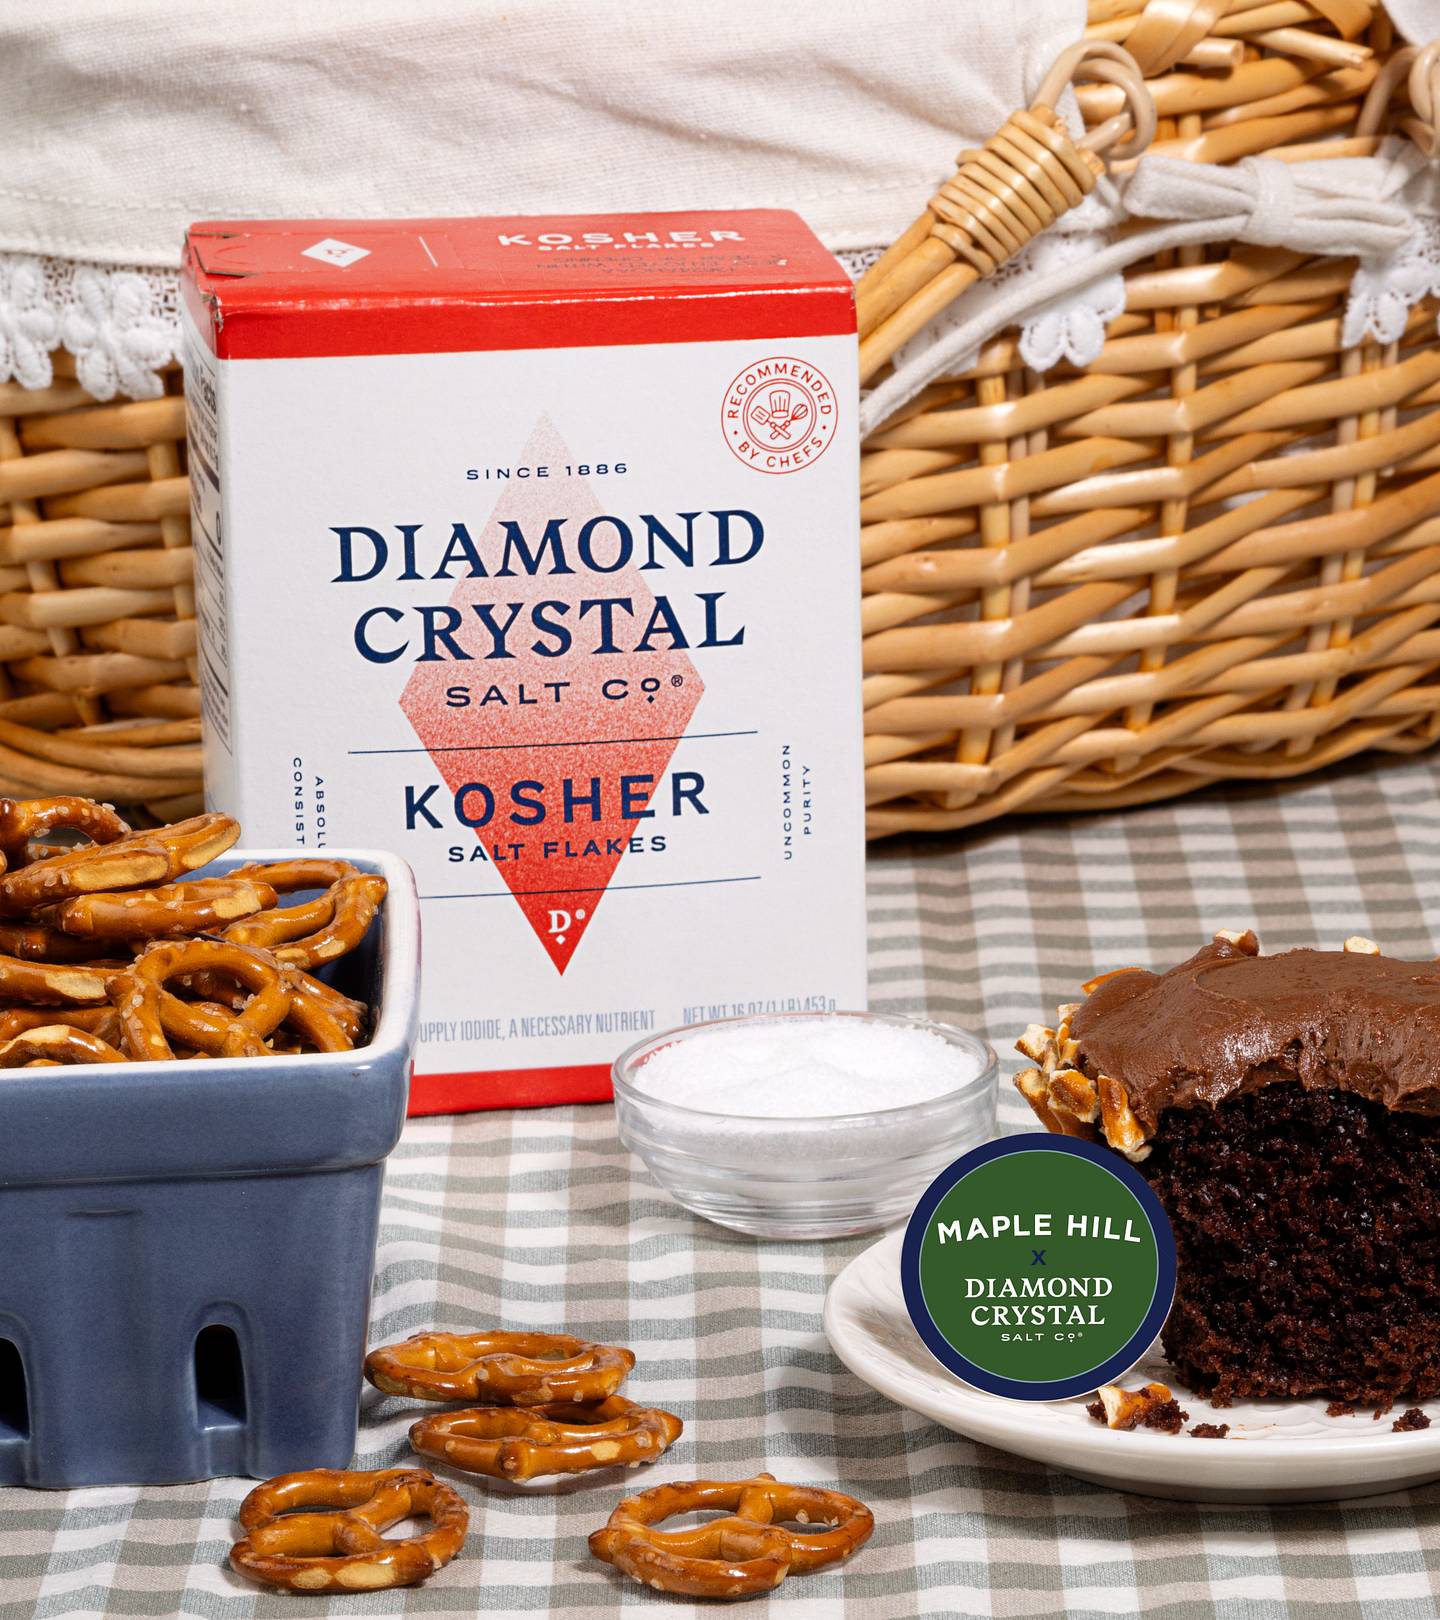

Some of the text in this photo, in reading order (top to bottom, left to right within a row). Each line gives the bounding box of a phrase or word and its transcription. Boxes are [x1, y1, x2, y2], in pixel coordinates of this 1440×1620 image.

[497, 230, 746, 247] KOSHER
[613, 241, 715, 250] FLAKES
[727, 362, 832, 419] RECOMMENDED
[738, 437, 823, 468] BY CHEFS
[466, 463, 629, 480] SINCE 1886
[328, 508, 765, 583] DIAMOND
[353, 591, 746, 665] CRYSTAL
[445, 682, 571, 708] SALT
[404, 771, 710, 830] KOSHER
[782, 745, 793, 861] UNCOMMON
[802, 765, 812, 835] PURITY
[448, 836, 668, 863] SALT FLAKES
[460, 1019, 506, 1042] IODIDE,
[508, 1018, 519, 1038] A
[521, 1013, 593, 1038] NECESSARY
[595, 1009, 656, 1033] NUTRIENT
[683, 1006, 705, 1024] NET
[708, 1004, 728, 1019] WT
[937, 1213, 1141, 1244] MAPLE HILL
[964, 1277, 1113, 1298] DIAMOND
[970, 1304, 1106, 1326] CRYSTAL
[1000, 1332, 1045, 1342] SALT
